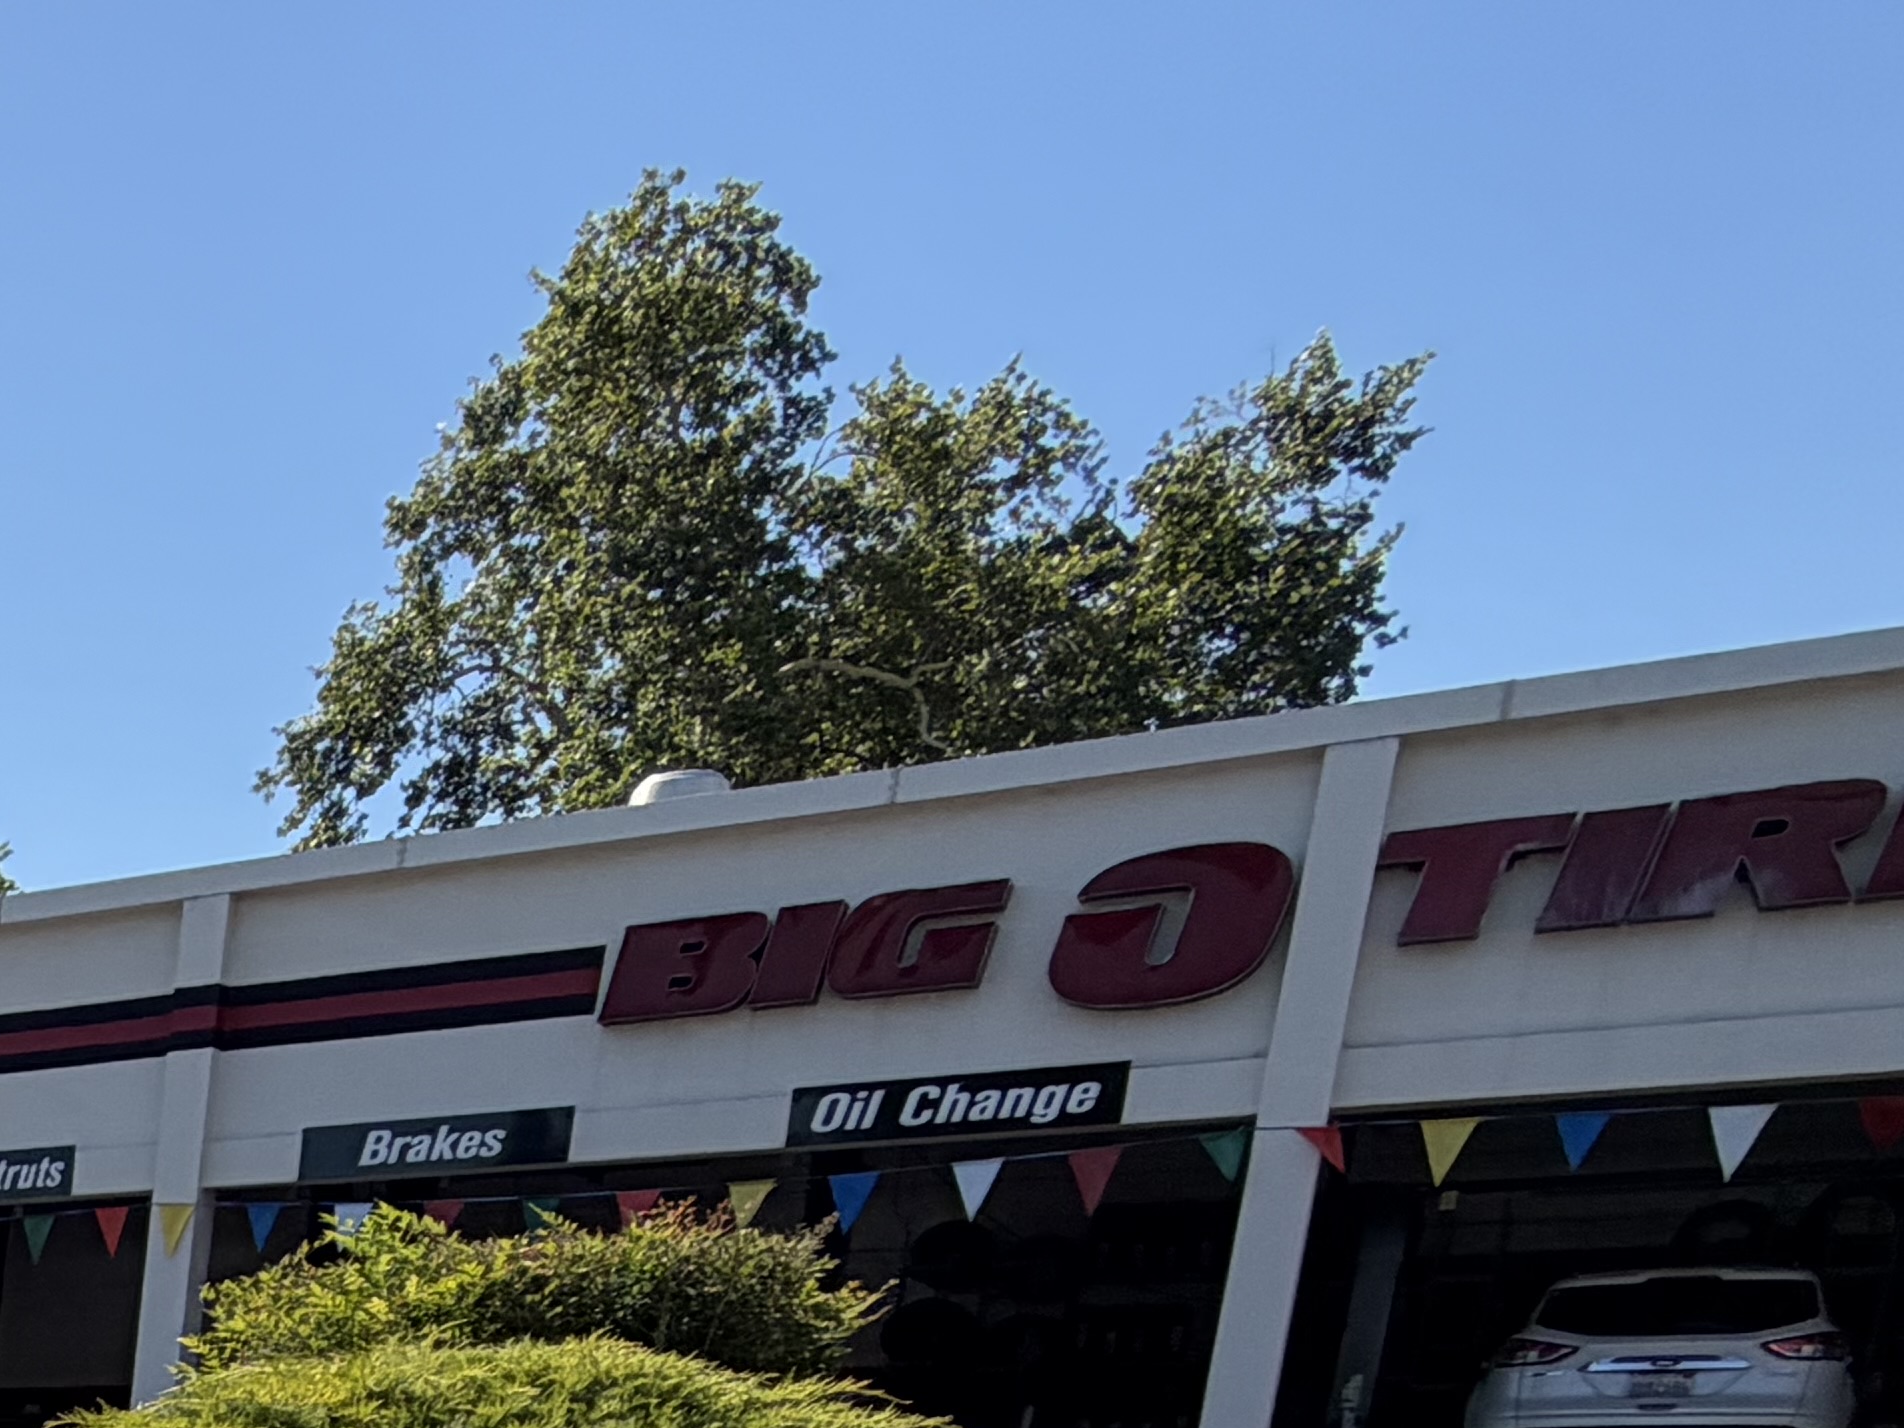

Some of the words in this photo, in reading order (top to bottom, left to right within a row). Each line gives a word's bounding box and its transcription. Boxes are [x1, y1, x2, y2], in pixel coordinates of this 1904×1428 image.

[597, 879, 1012, 1027] BIG
[1047, 840, 1297, 1011] O
[1383, 778, 1904, 946] TIR
[810, 1089, 885, 1133] Oil
[898, 1081, 1101, 1127] Change
[357, 1125, 507, 1166] Brakes
